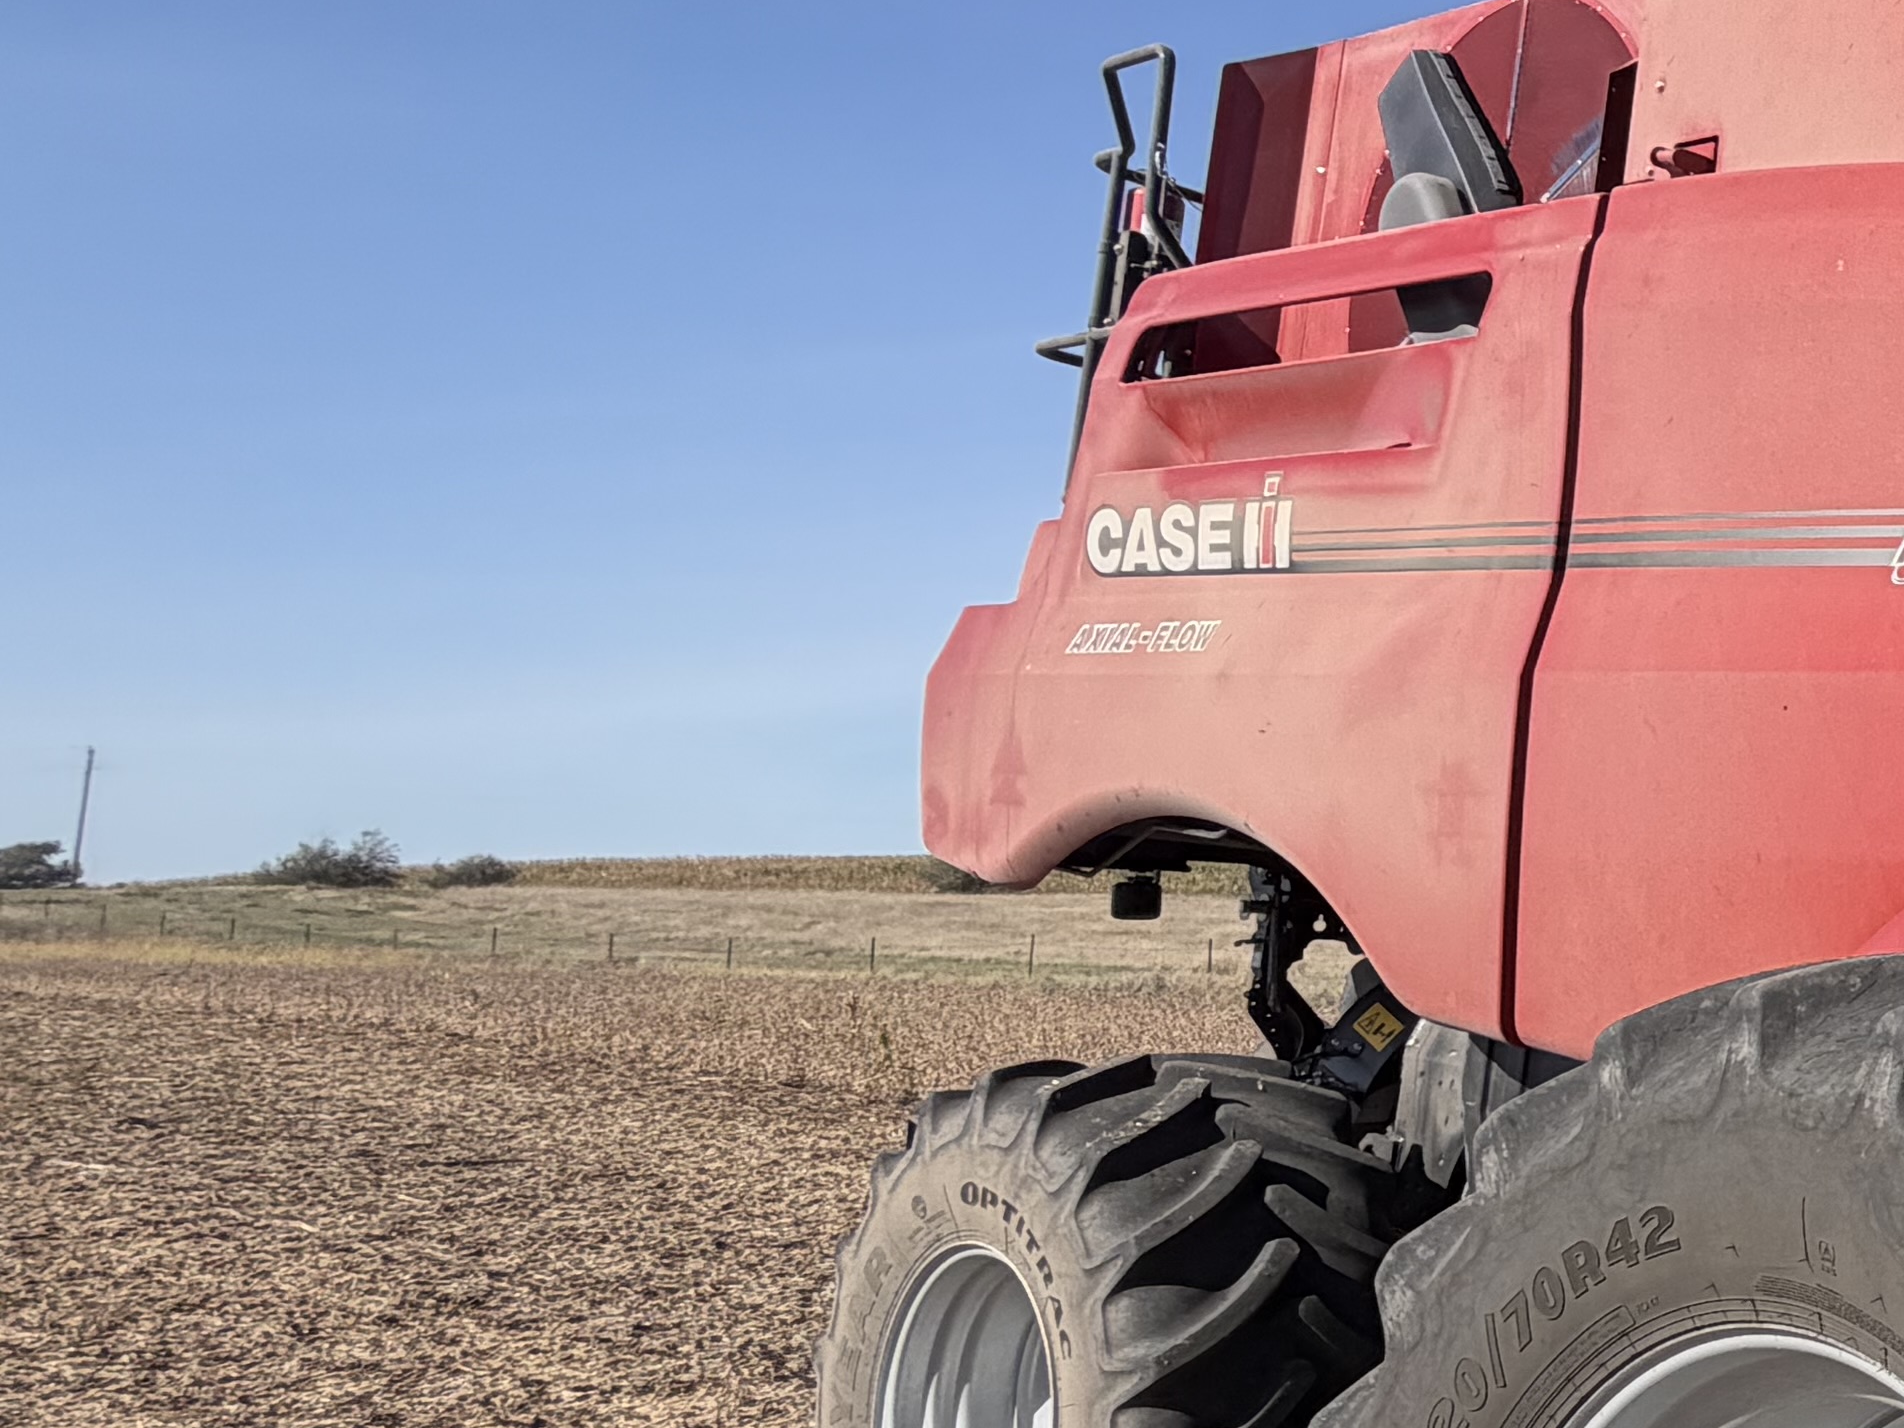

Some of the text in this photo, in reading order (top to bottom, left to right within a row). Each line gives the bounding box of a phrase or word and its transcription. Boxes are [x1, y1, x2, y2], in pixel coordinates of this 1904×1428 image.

[1086, 502, 1235, 573] CASE
[1064, 620, 1222, 654] AXIAL-FLOW
[960, 1181, 1072, 1360] OPTITRAC
